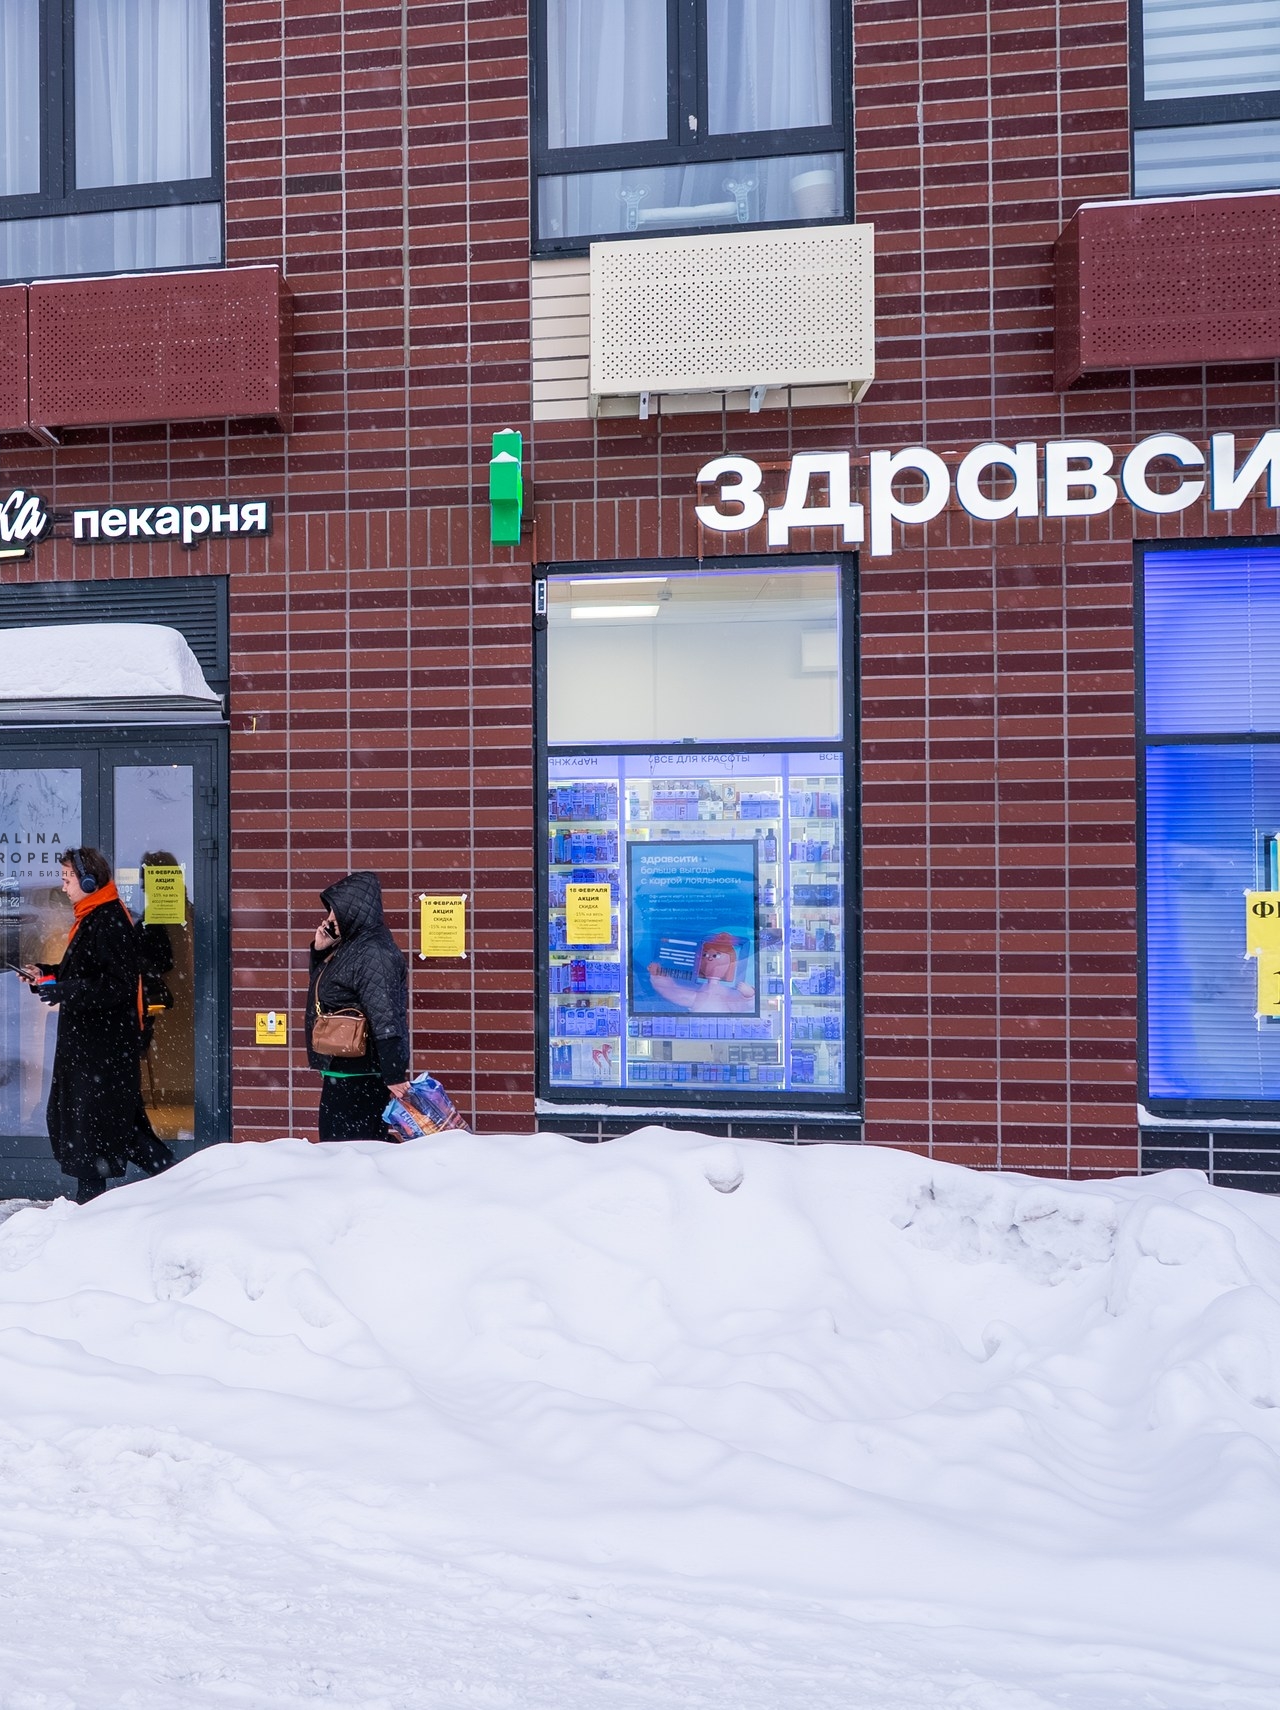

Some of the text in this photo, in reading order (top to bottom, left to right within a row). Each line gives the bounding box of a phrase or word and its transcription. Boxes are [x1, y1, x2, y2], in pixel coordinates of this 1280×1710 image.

[694, 429, 1280, 557] здравси
[74, 502, 267, 543] пекарня
[676, 755, 698, 764] ДЛЯ
[701, 754, 750, 763] КРАСОТЫ
[640, 856, 698, 865] здравсити
[640, 866, 677, 874] больше
[649, 876, 682, 886] картой
[1252, 901, 1280, 918] Ф
